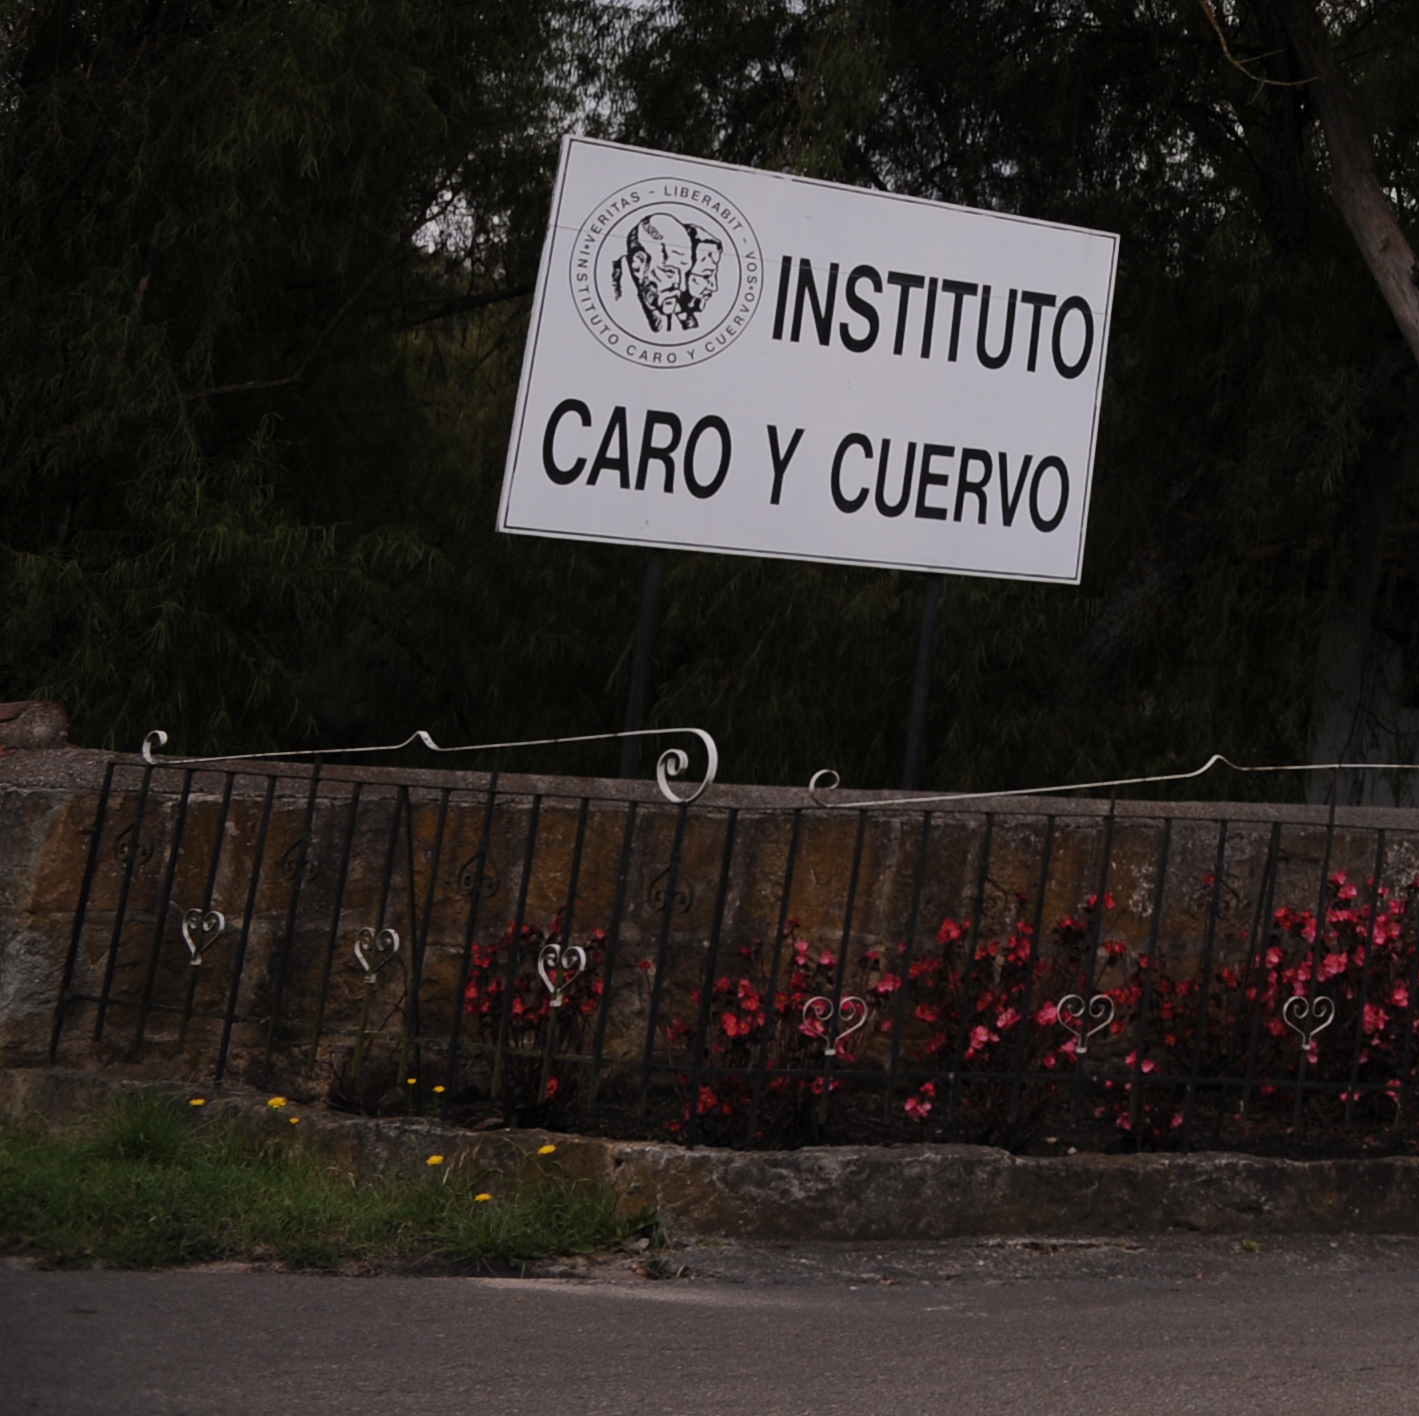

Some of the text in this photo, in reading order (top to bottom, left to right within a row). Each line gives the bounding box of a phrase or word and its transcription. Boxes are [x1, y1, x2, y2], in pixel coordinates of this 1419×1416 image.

[585, 185, 758, 286] VERITAS LIBERABIT VOS
[576, 250, 756, 364] INSTITUTO CARO Y CUERVO
[771, 255, 1094, 380] INSTITUTO
[541, 398, 1070, 533] CARO Y CUERVO
